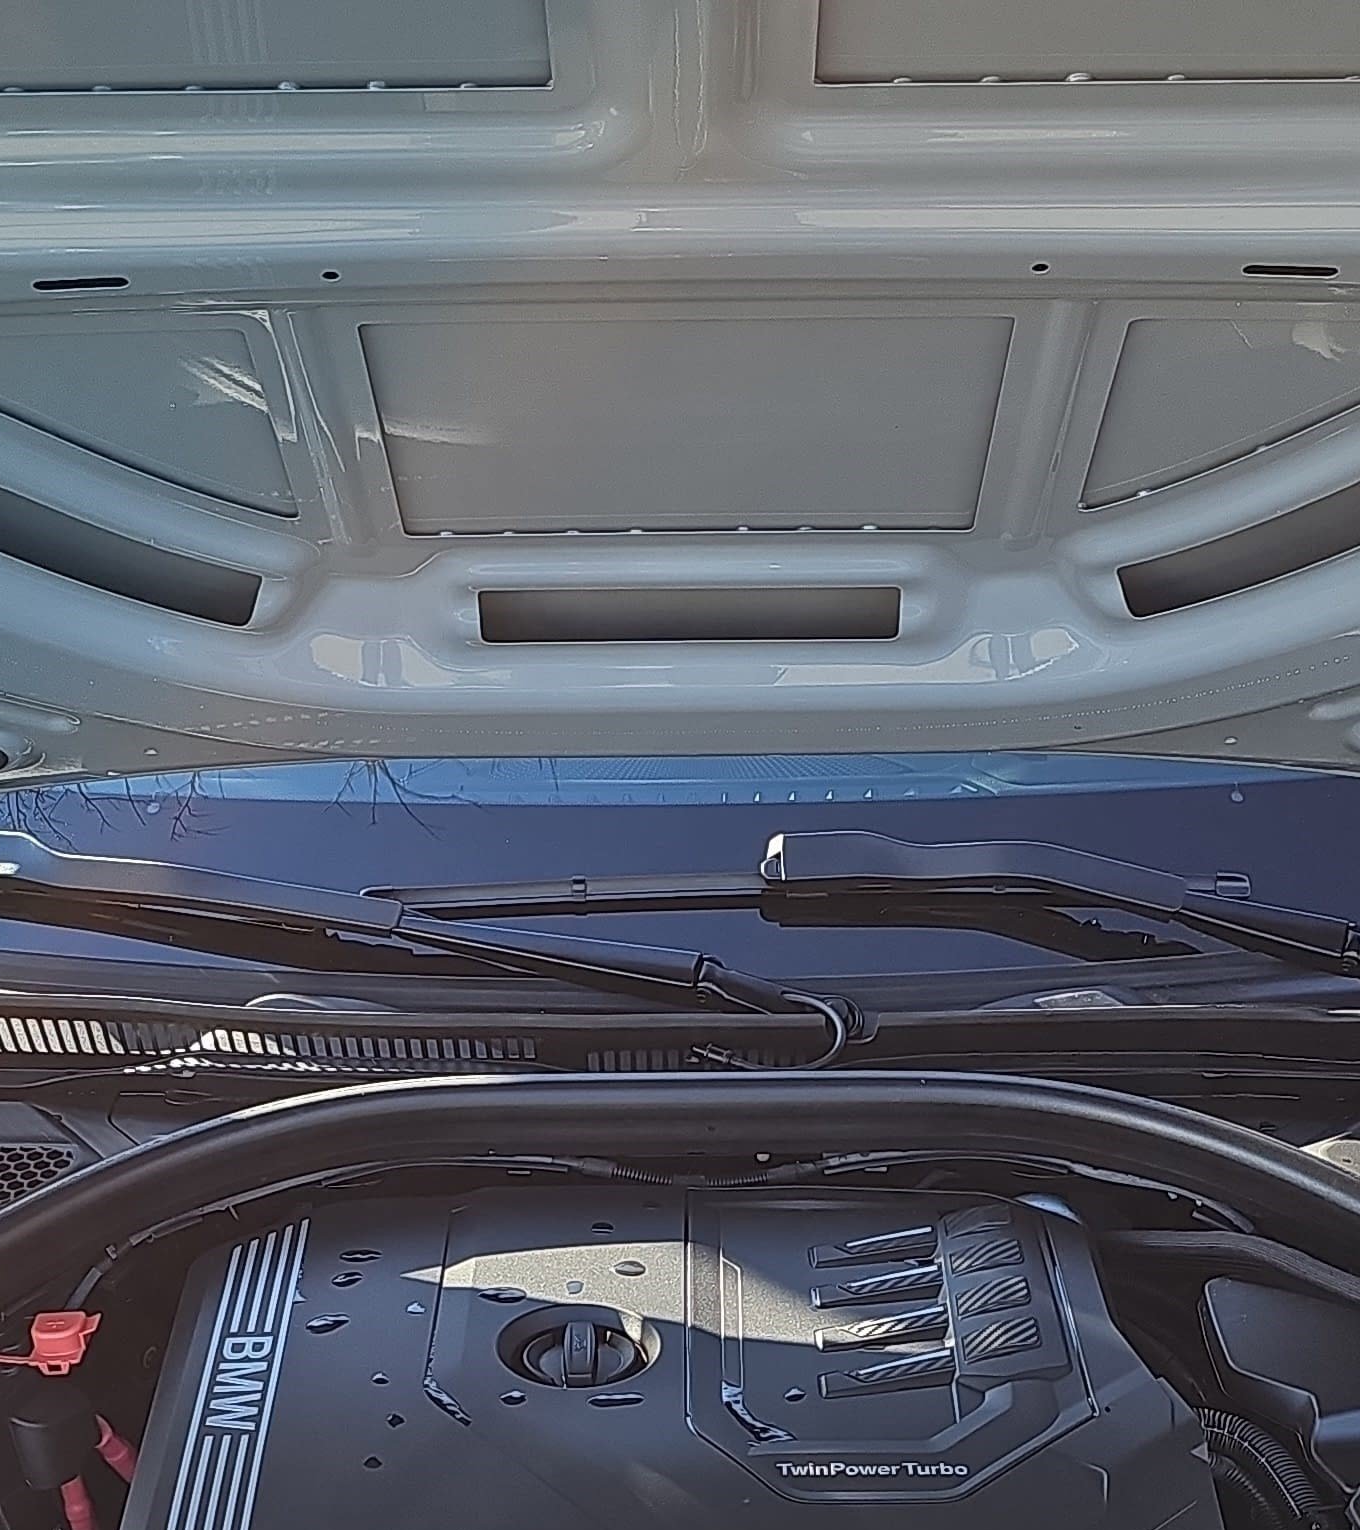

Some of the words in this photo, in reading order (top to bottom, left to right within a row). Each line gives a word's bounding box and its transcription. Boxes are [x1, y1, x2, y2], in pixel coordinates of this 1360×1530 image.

[205, 1335, 274, 1431] BMW
[776, 1462, 900, 1477] TwinPower
[901, 1462, 969, 1477] Turbo
